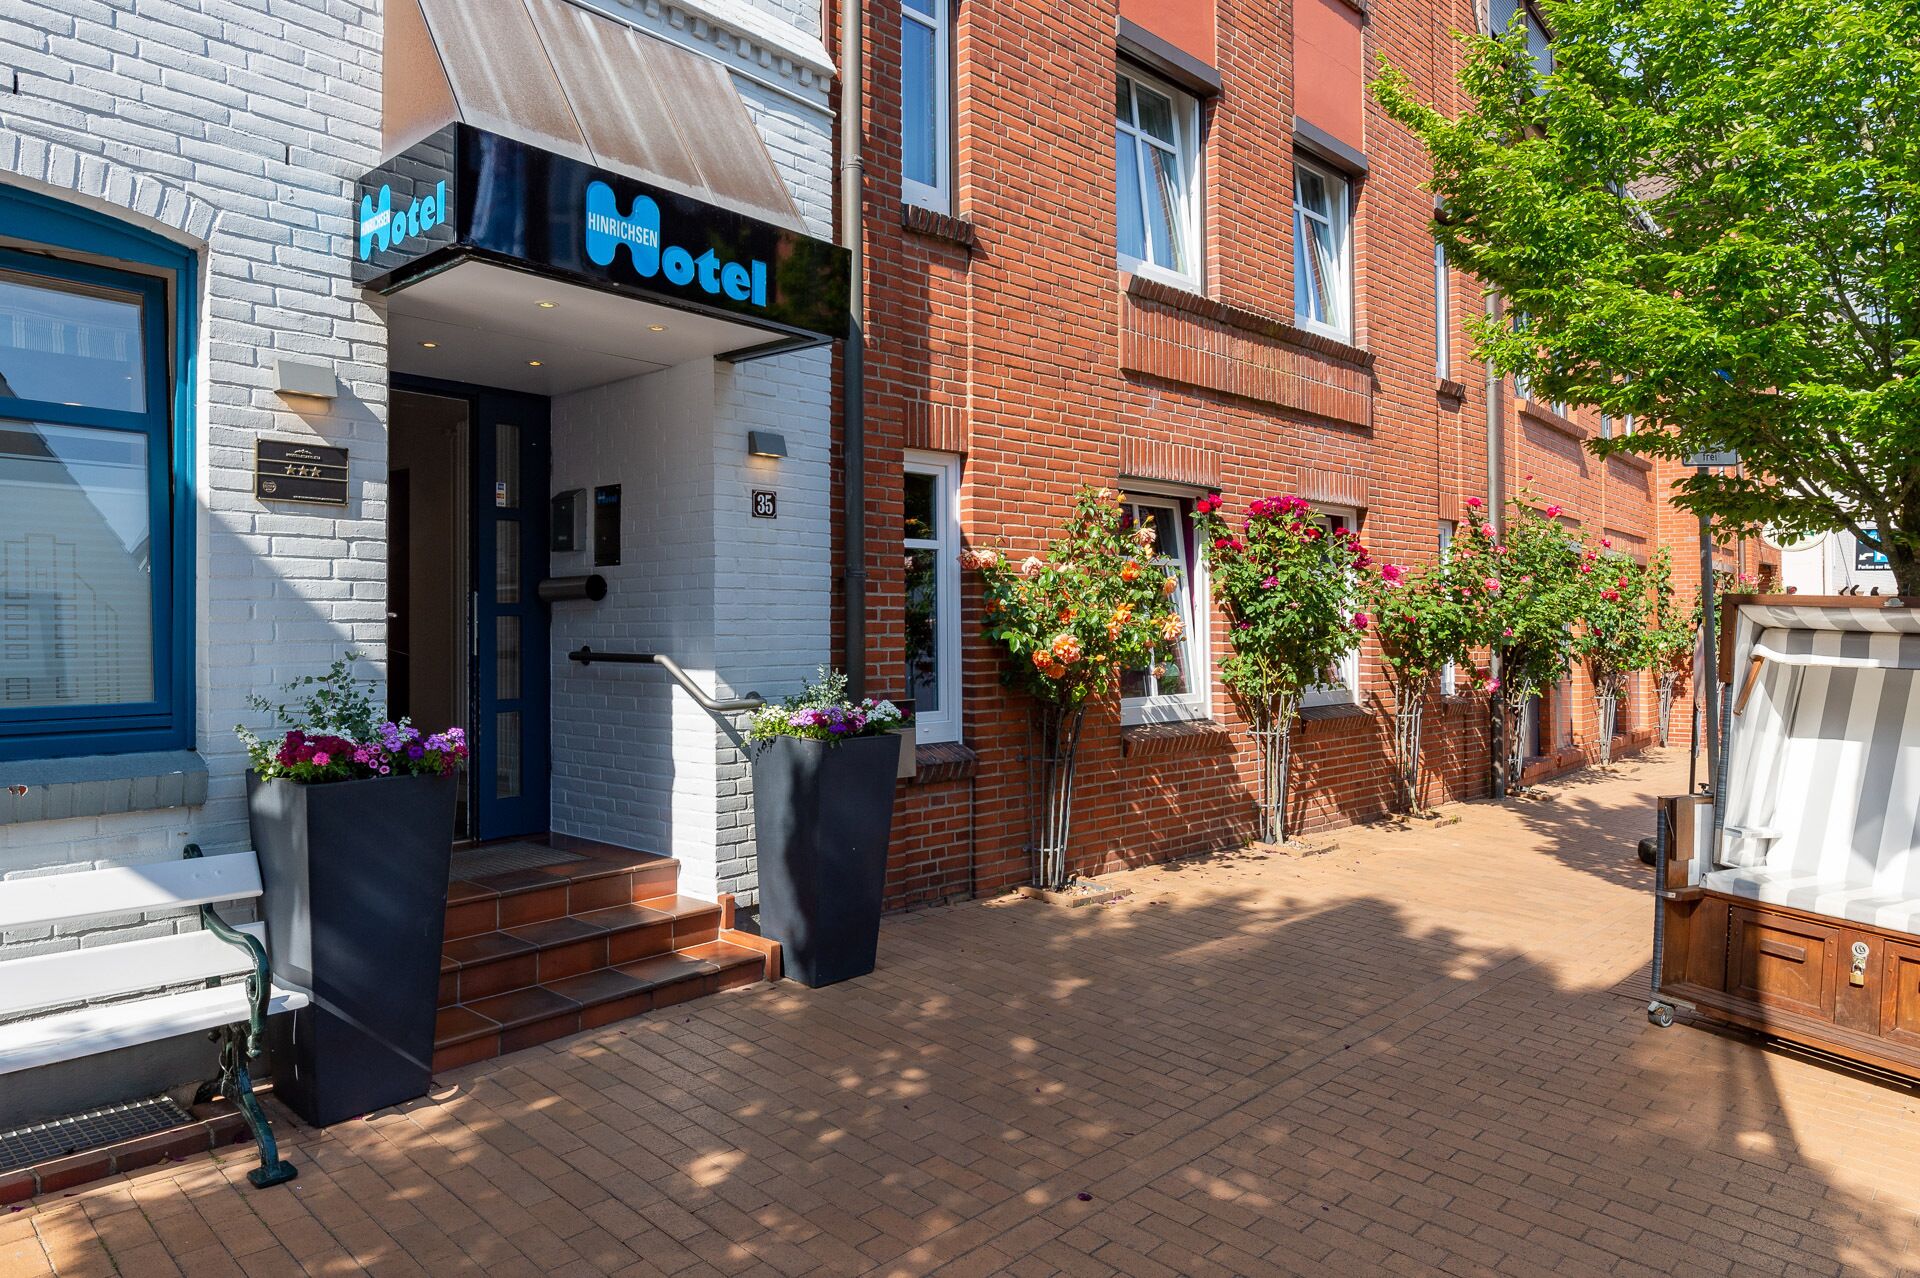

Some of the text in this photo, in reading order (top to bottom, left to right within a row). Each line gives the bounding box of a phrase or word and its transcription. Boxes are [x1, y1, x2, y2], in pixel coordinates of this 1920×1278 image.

[360, 179, 446, 262] Hotel
[587, 211, 659, 249] HINRICHSEN
[586, 181, 767, 307] Hotel
[1702, 453, 1718, 461] frei
[757, 494, 773, 514] 35
